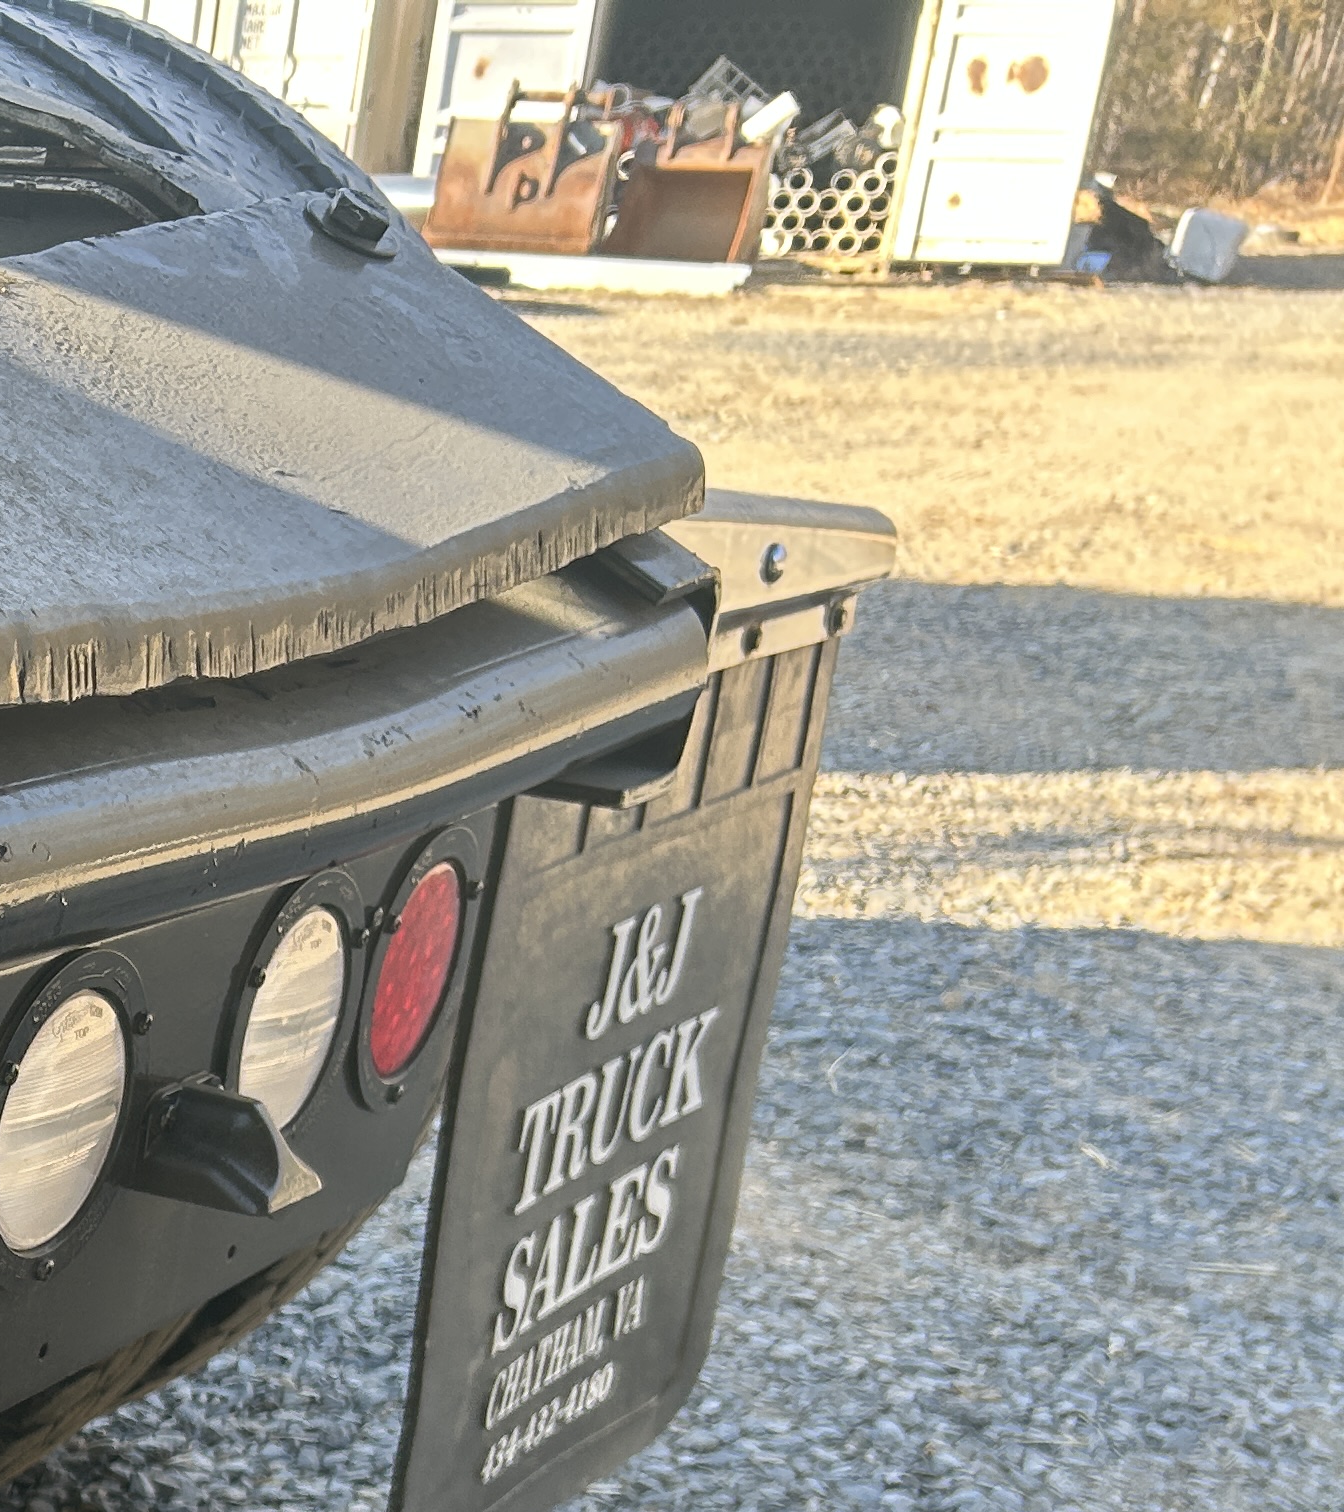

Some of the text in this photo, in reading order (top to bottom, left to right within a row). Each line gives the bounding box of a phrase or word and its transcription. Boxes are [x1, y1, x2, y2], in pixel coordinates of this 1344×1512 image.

[586, 888, 703, 1040] J&J
[515, 1008, 719, 1215] TRUCK
[491, 1145, 680, 1356] SALES
